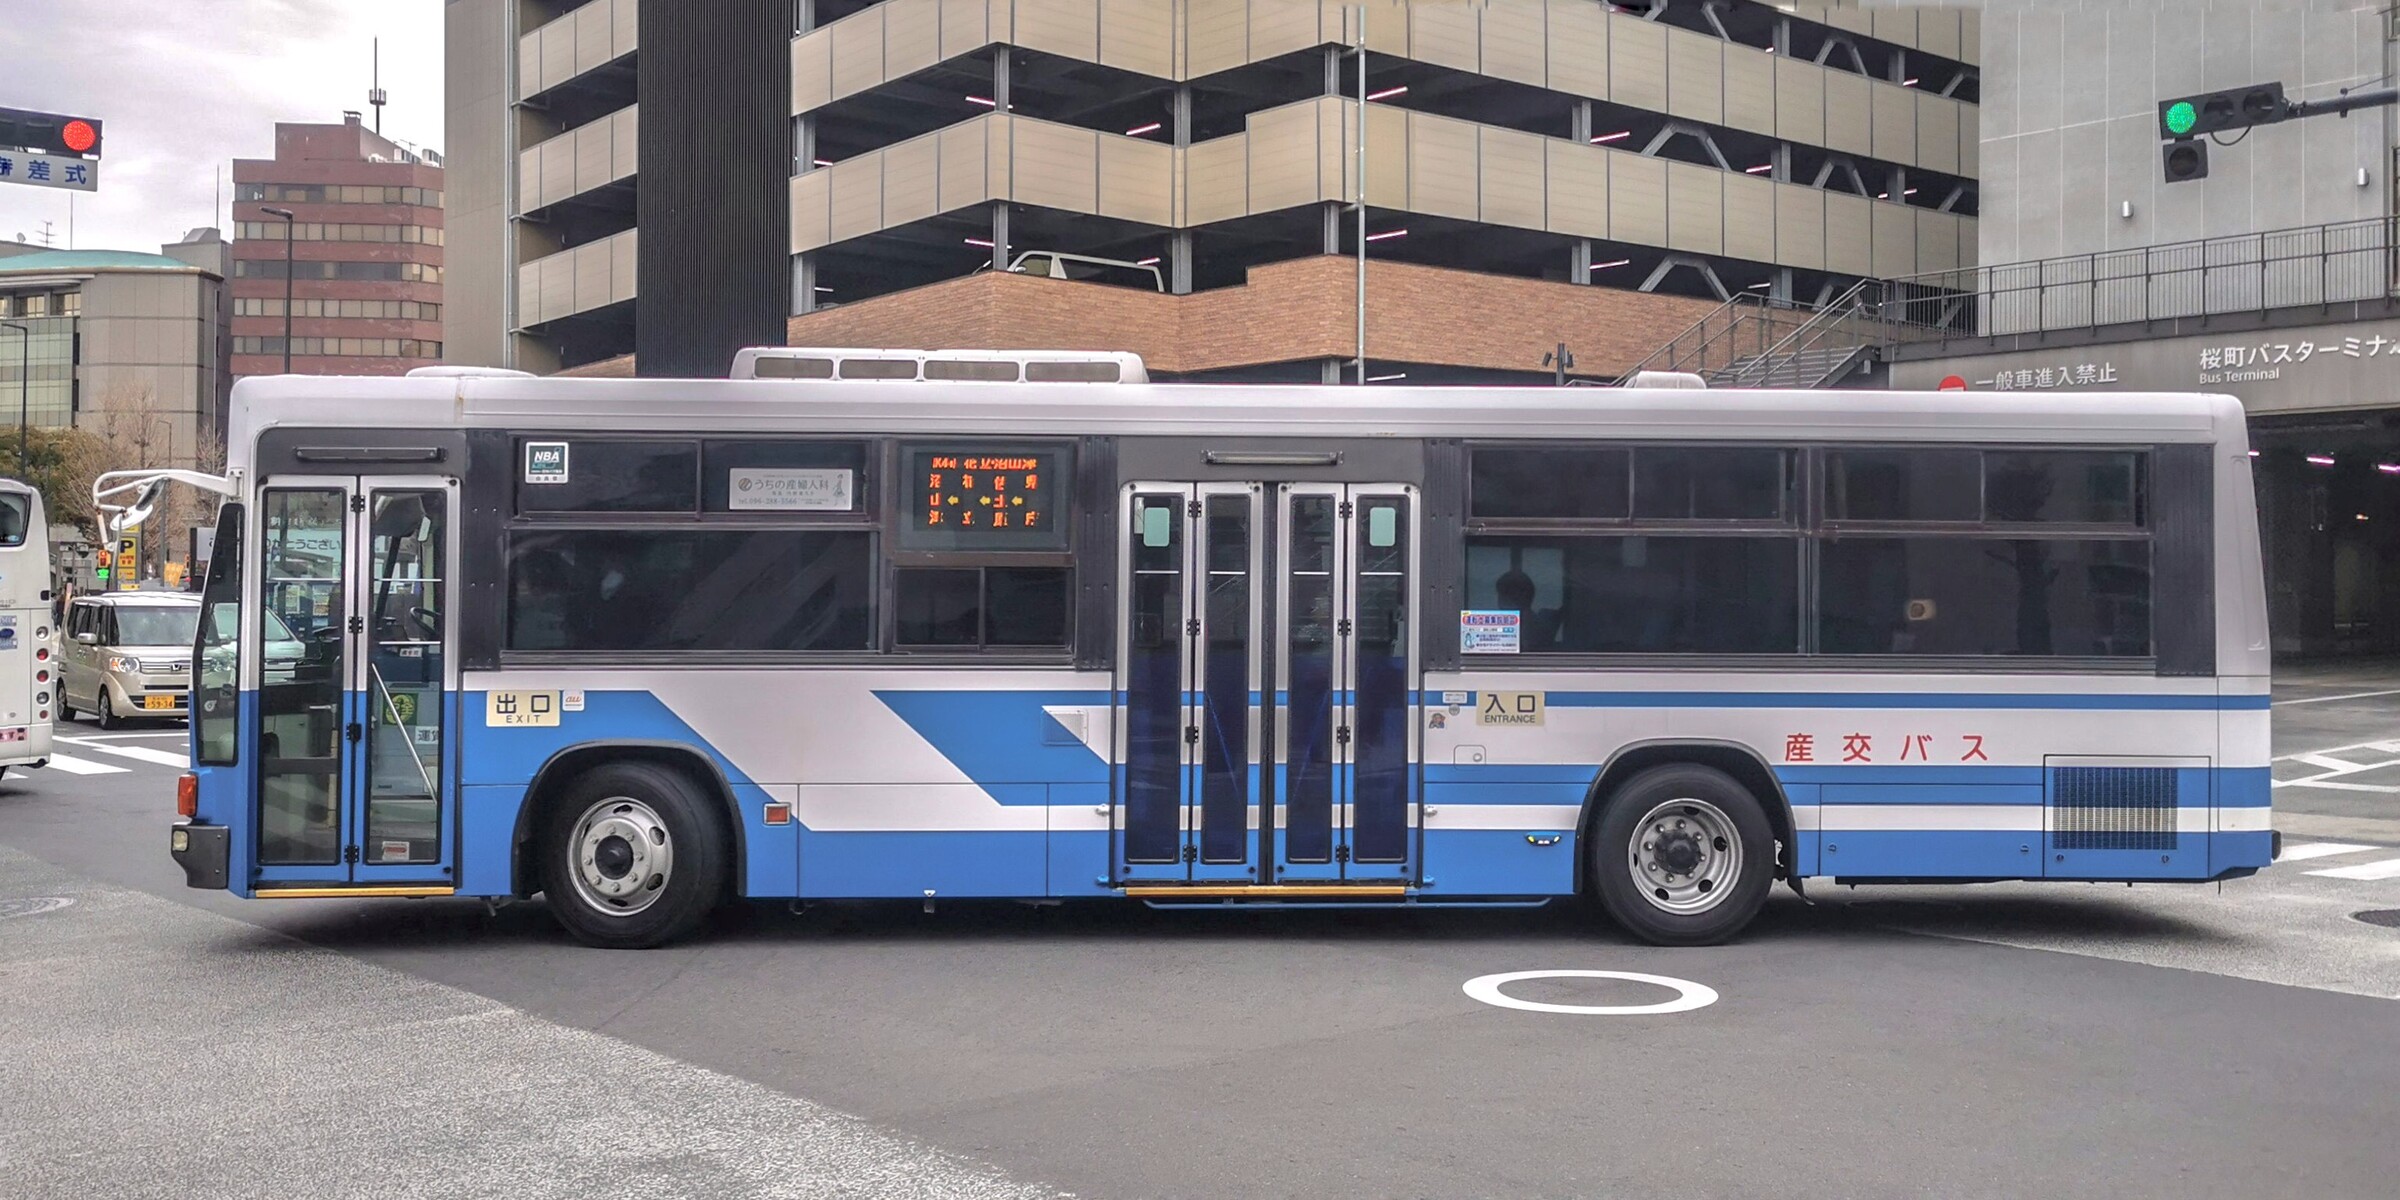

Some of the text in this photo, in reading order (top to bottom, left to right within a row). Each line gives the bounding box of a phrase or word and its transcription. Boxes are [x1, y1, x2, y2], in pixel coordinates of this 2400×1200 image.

[1976, 362, 2118, 391] 一般車進入禁止
[2200, 367, 2280, 385] Bus Terminal
[534, 451, 560, 463] NBA
[120, 540, 134, 553] P
[496, 693, 550, 714] 出口
[1485, 694, 1536, 714] 入口
[506, 714, 541, 723] EXIT
[1484, 714, 1536, 723] ENTRANCE
[1785, 732, 1988, 762] 産交バス
